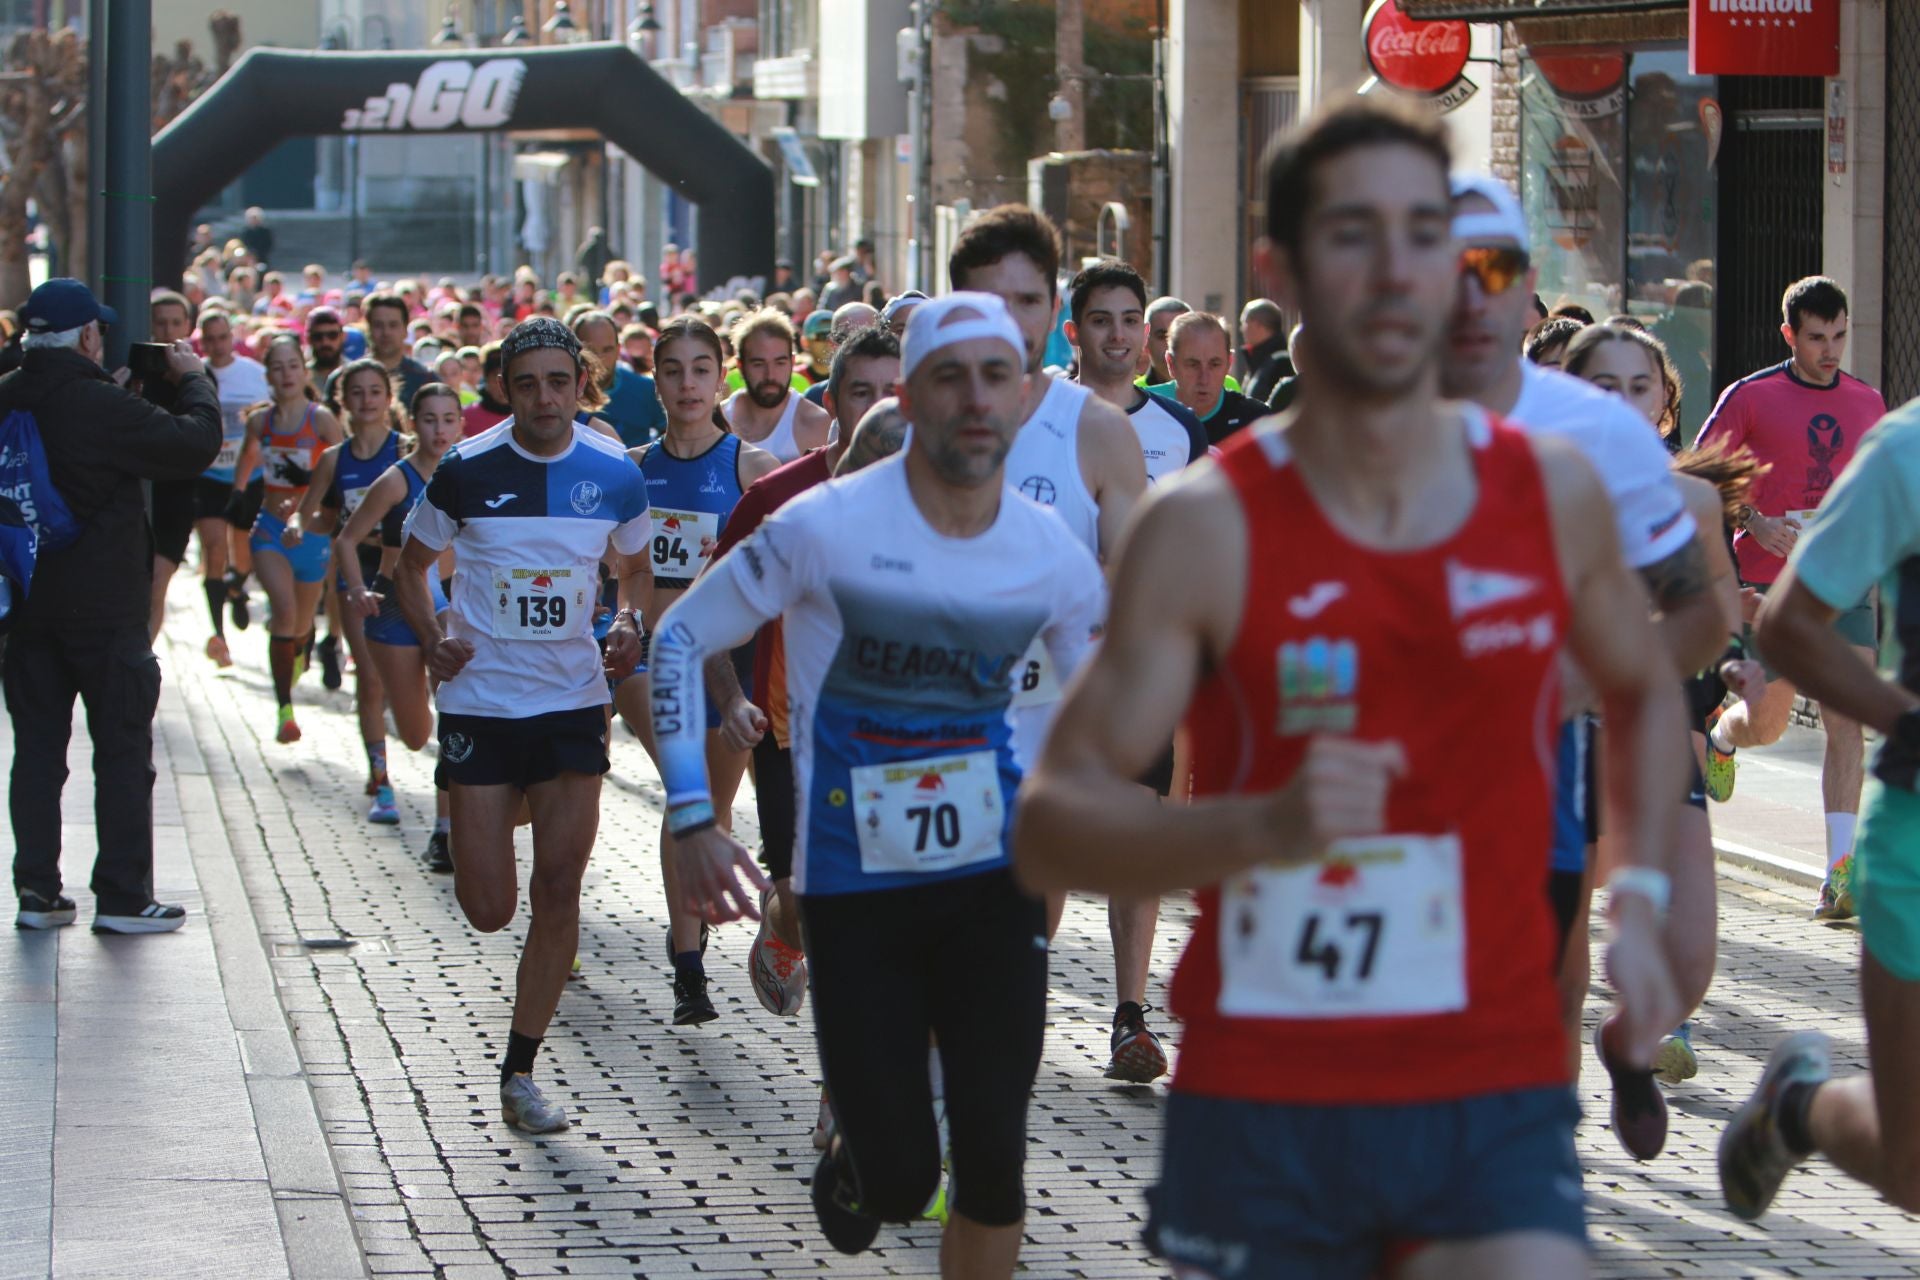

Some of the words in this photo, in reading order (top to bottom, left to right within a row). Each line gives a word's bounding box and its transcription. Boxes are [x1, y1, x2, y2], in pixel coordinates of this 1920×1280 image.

[653, 535, 688, 566] 94
[517, 596, 566, 628] 139
[906, 802, 960, 852] 70
[1296, 911, 1384, 981] 47
